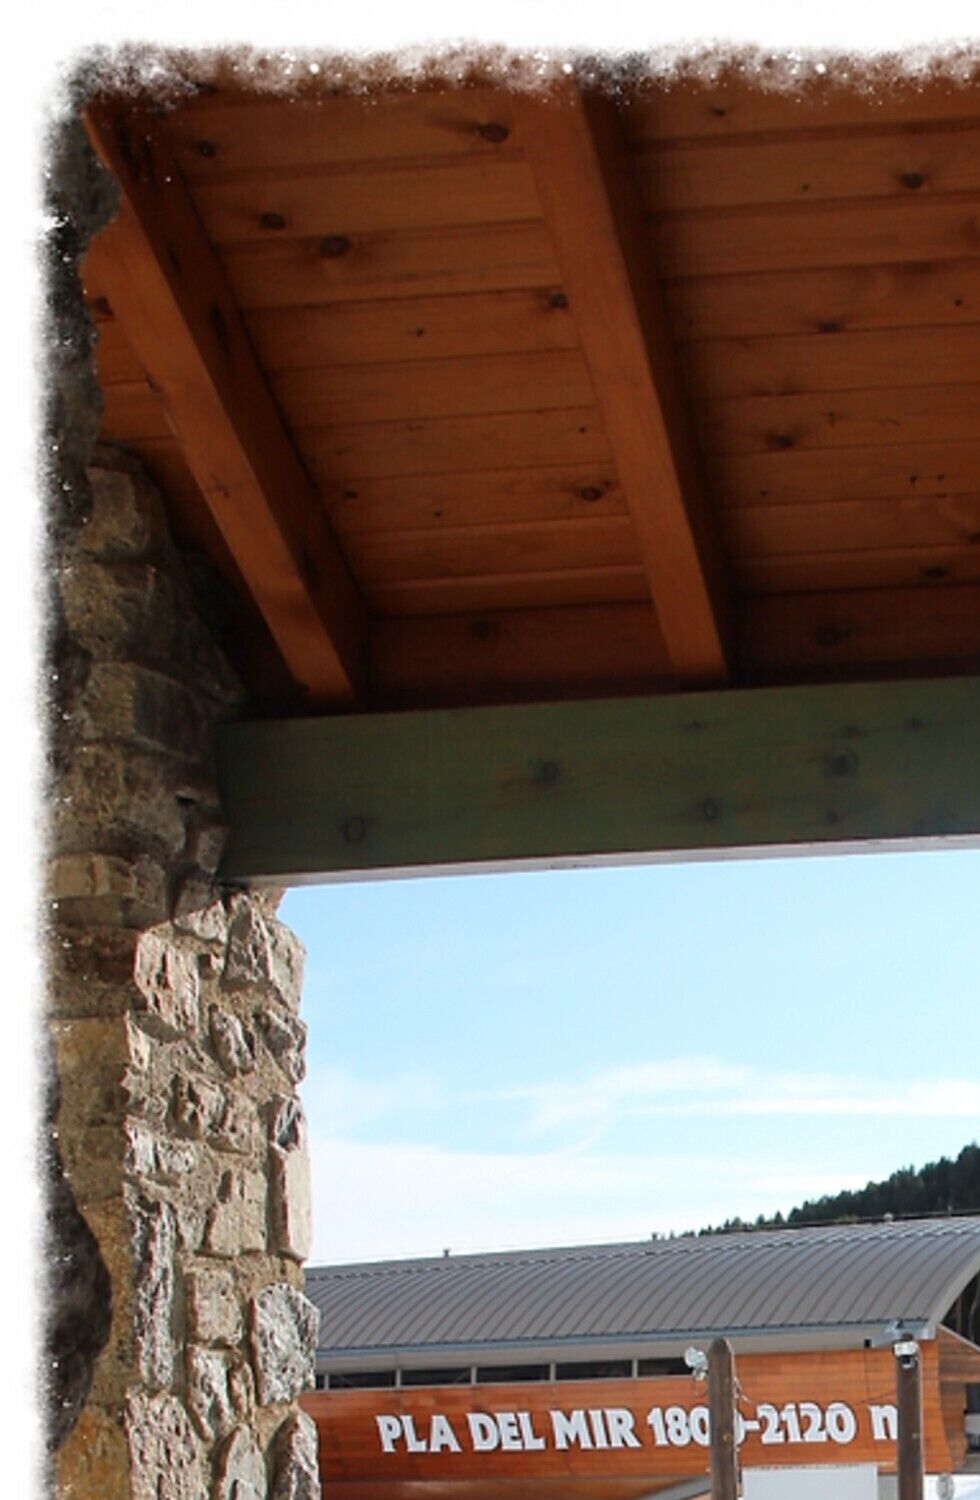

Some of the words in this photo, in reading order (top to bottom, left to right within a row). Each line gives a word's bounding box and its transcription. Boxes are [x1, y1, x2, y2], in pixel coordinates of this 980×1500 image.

[376, 1414, 462, 1452] PLA
[466, 1411, 546, 1451] DEL
[550, 1408, 642, 1450] MIR
